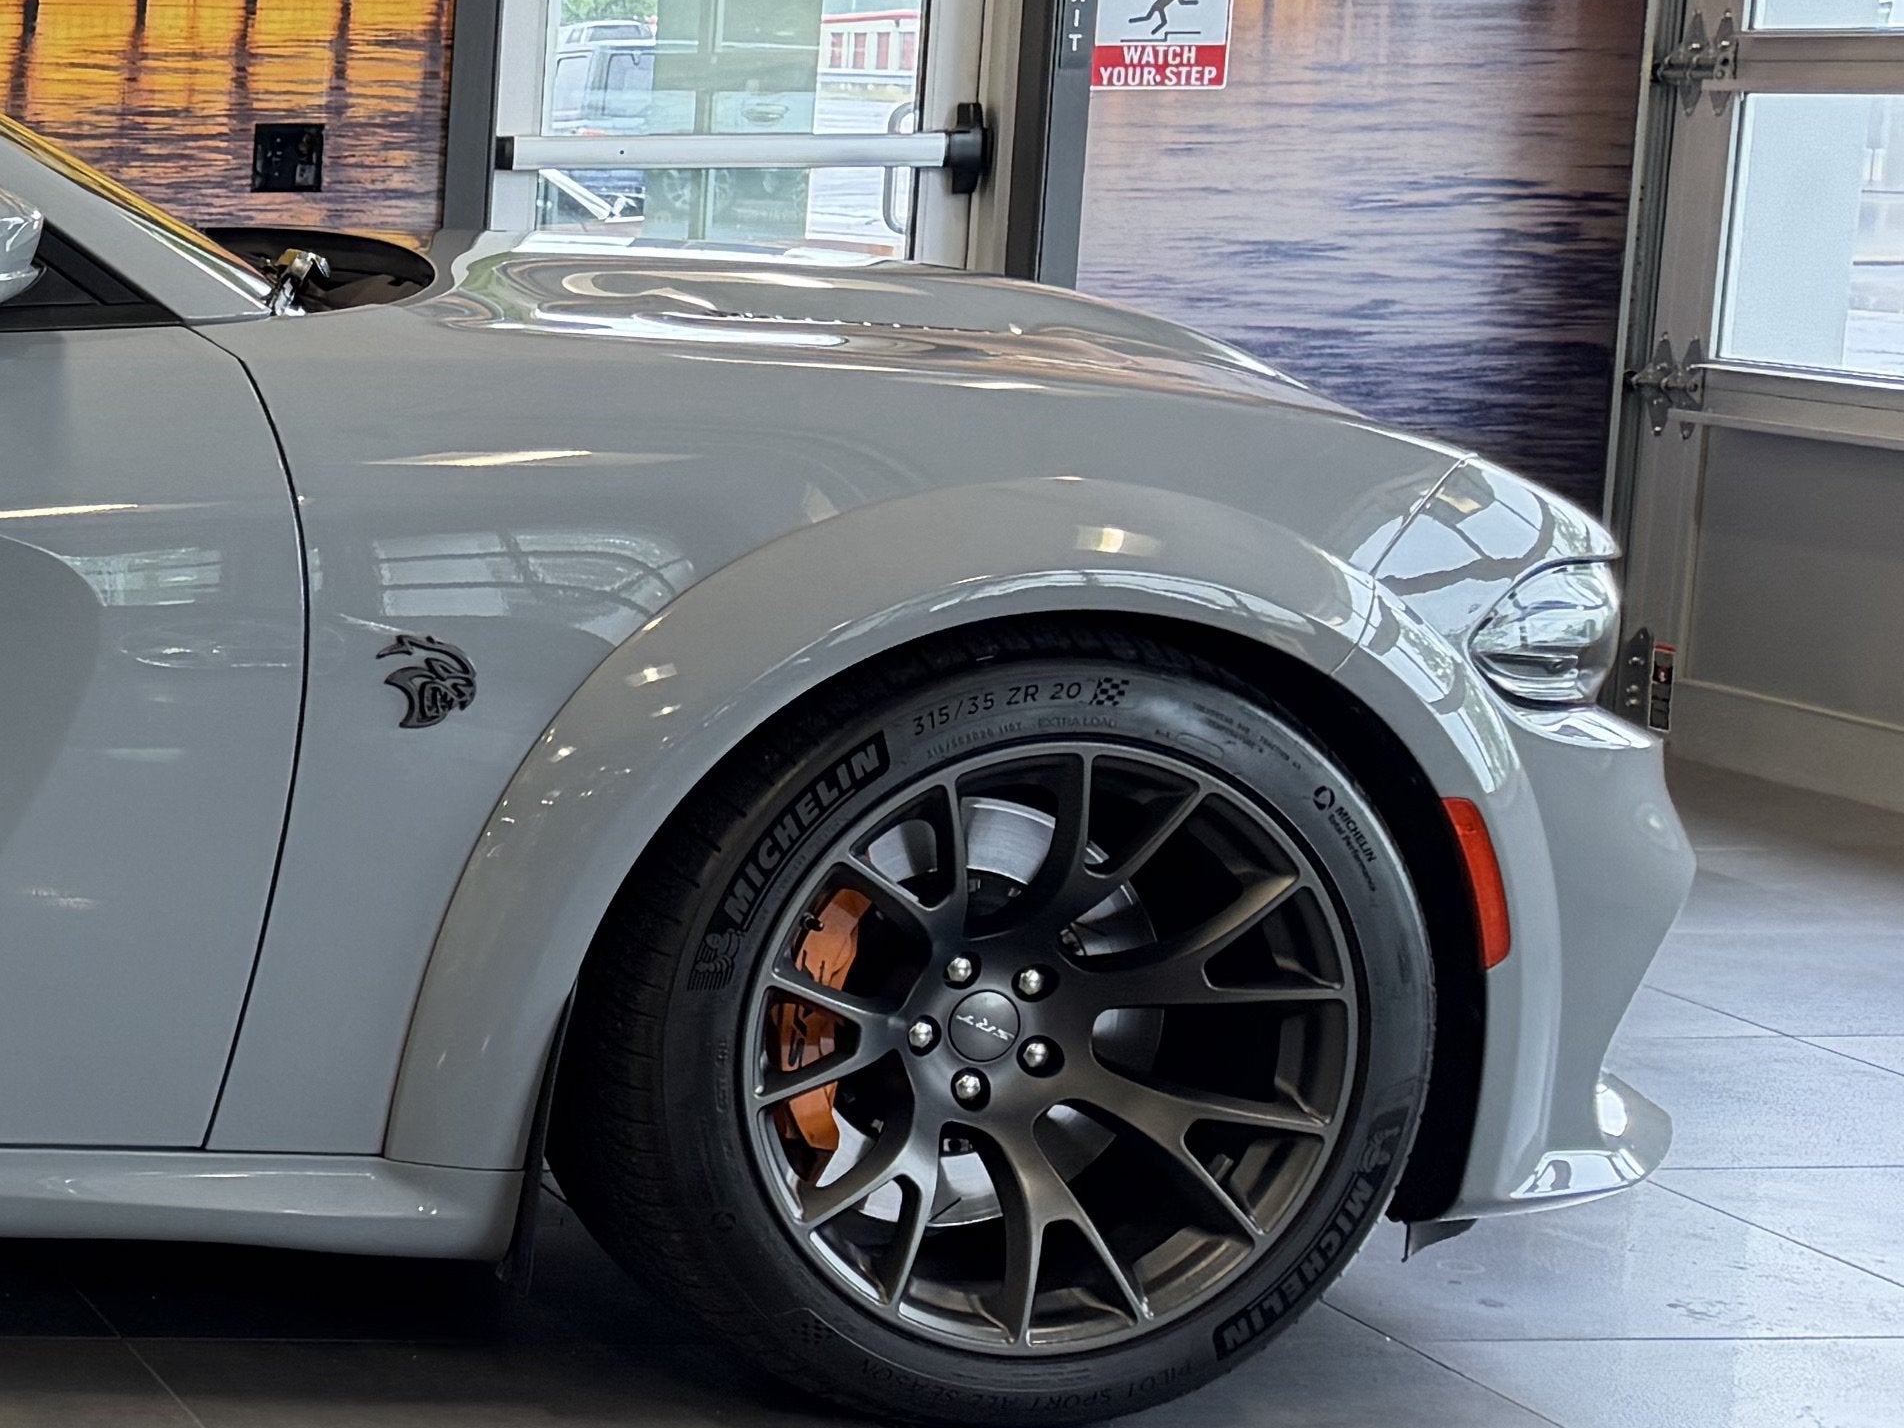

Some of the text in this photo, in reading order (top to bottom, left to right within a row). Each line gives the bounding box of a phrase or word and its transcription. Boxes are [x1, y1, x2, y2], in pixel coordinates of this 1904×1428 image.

[1100, 66, 1217, 86] YOUR STEP
[1123, 46, 1196, 65] WATCH
[912, 681, 1082, 736] 315/35 ZR 20
[724, 743, 880, 924] MICHELIN
[1335, 806, 1377, 863] MICHELIN
[955, 1014, 1015, 1041] SRT
[1222, 1176, 1374, 1350] MICHELIN
[1029, 1387, 1112, 1413] SPORT
